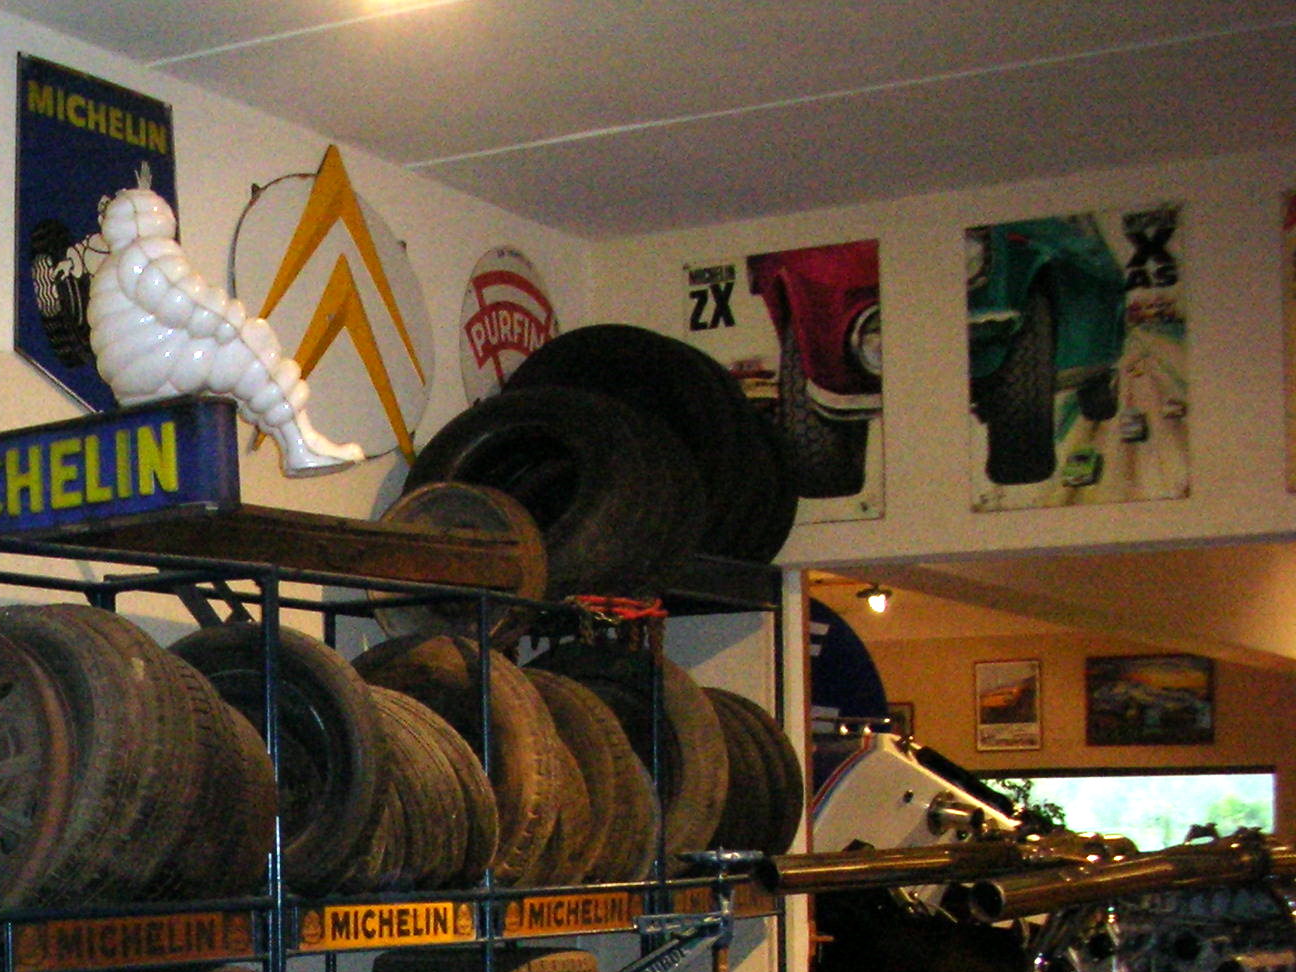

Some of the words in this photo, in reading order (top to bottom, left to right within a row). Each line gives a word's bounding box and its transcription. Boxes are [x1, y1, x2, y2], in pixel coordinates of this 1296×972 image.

[27, 79, 167, 155] MICHELIN
[689, 282, 736, 331] ZX
[471, 309, 545, 358] PURFIN
[330, 906, 449, 941] MICHELIN
[529, 893, 630, 929] MICHELIN
[57, 918, 216, 960] MICHELIN
